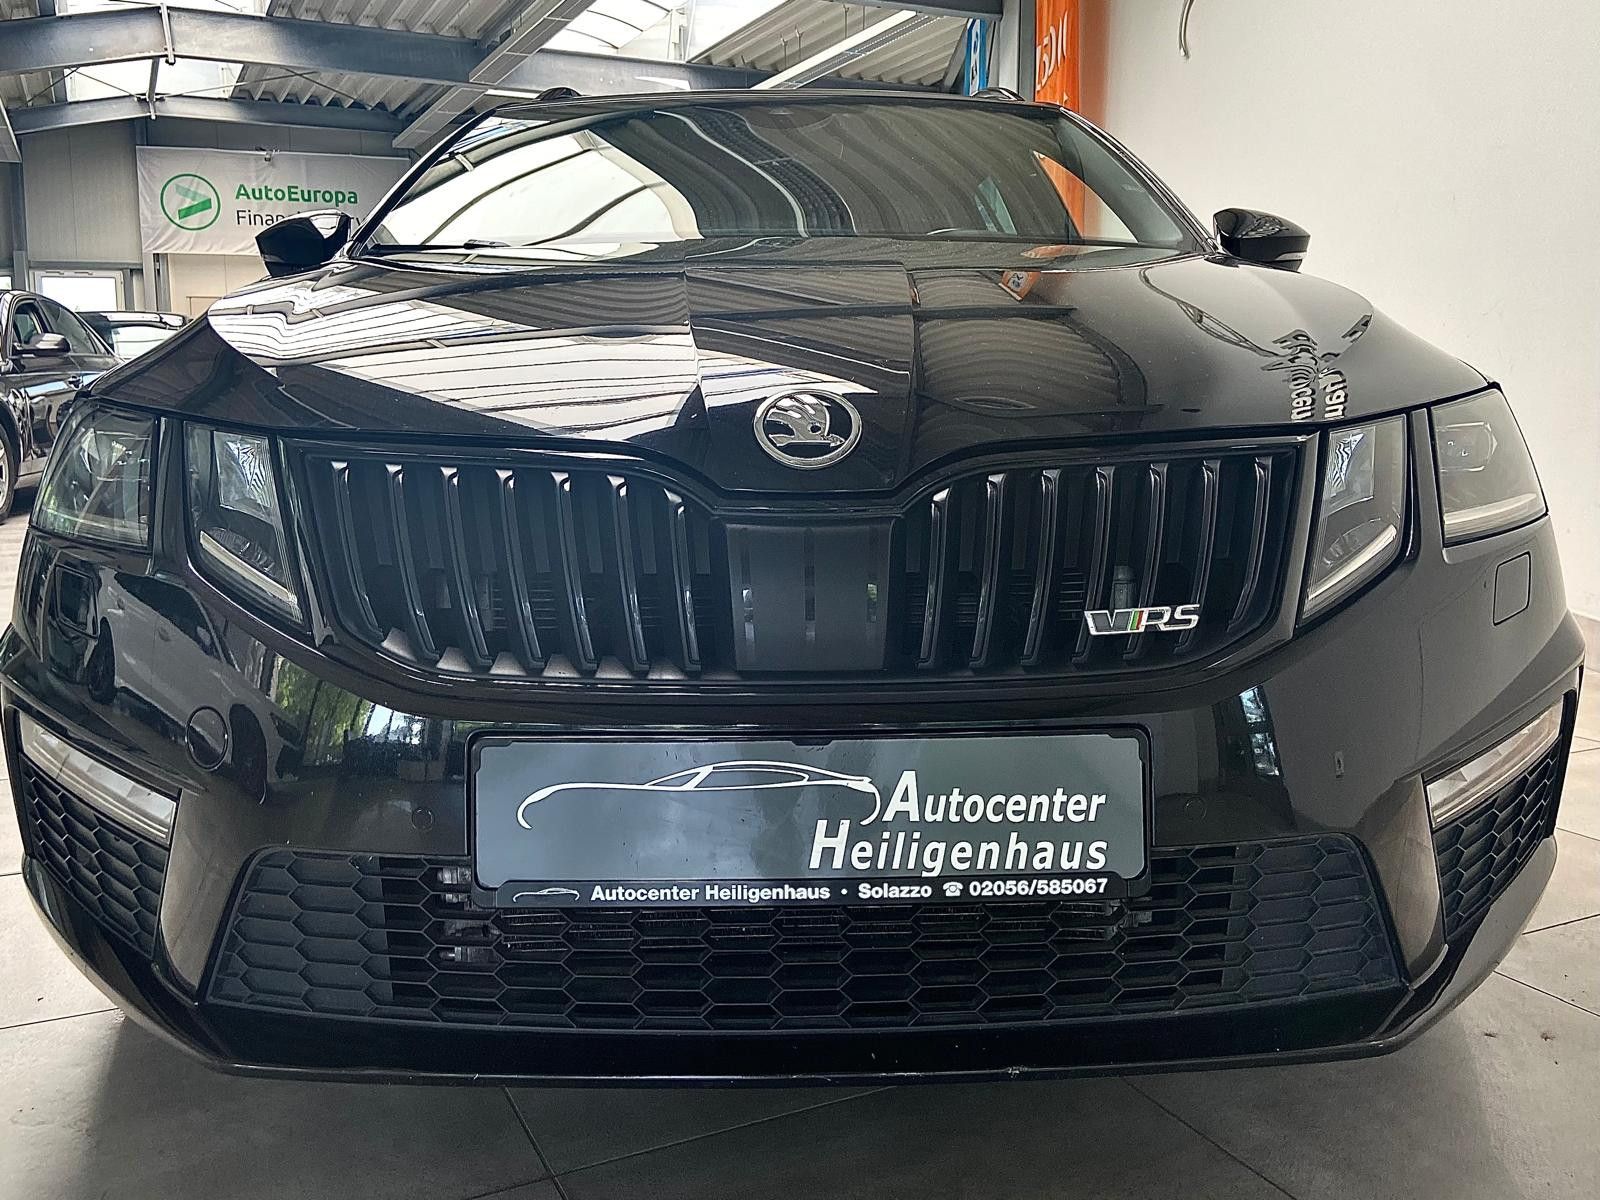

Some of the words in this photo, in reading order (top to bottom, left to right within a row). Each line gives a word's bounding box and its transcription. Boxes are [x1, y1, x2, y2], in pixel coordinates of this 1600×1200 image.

[235, 183, 359, 207] AutoEuropa
[882, 770, 1107, 823] Autocenter
[808, 819, 1108, 877] Heiligenhaus
[590, 885, 700, 902] Autocenter
[705, 884, 831, 904] Heiligenhaus
[858, 882, 932, 899] Solazzo
[969, 878, 1108, 897] 02056/585067
